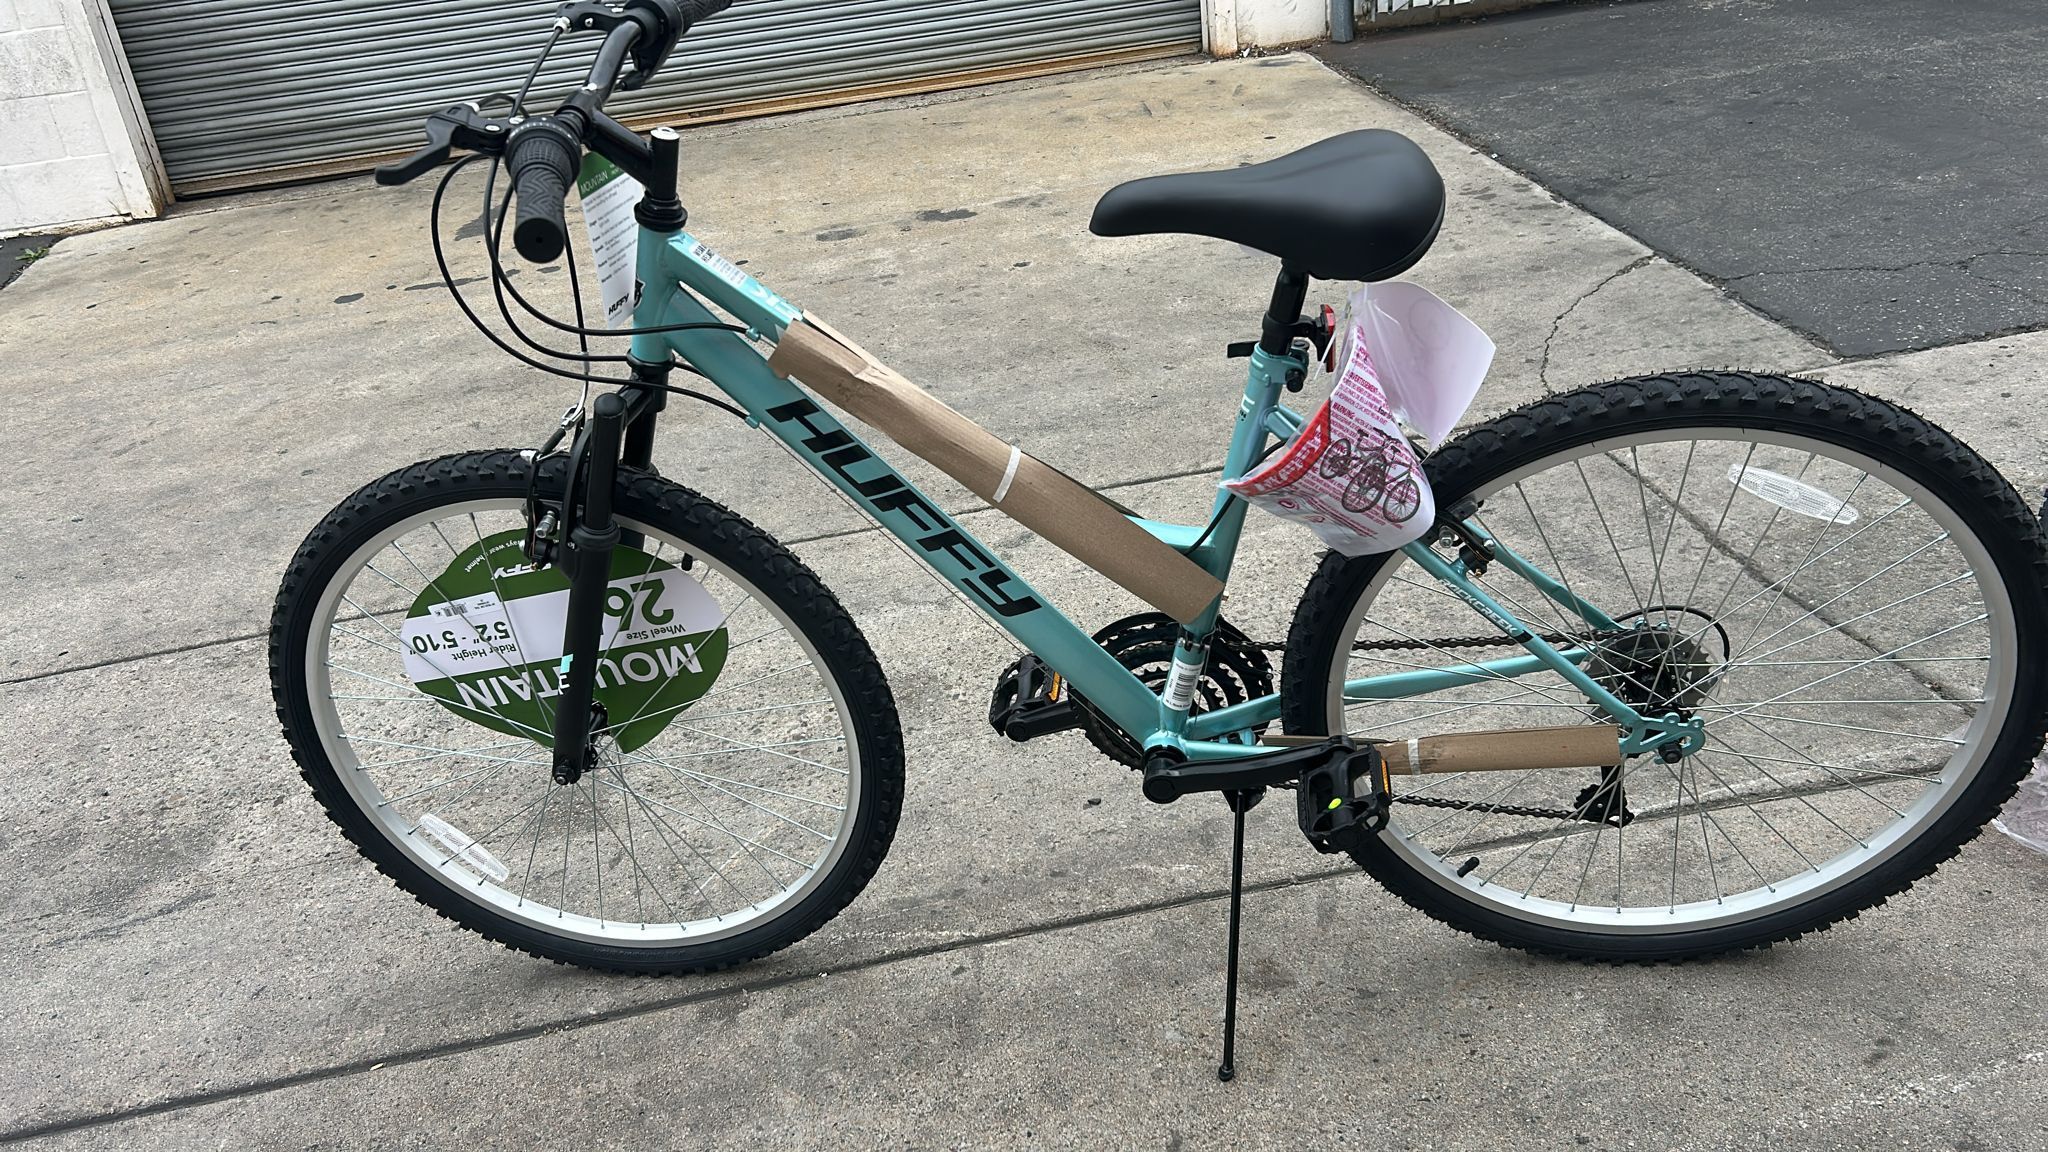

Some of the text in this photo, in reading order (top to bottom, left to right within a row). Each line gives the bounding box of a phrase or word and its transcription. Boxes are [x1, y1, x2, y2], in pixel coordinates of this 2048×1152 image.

[580, 170, 608, 194] MOUNTAIN
[608, 293, 629, 315] HUFFY
[766, 398, 1043, 617] HUFFY
[465, 554, 486, 573] helmet
[626, 624, 686, 640] Wheel Size
[452, 643, 517, 661] Rider Height
[455, 643, 703, 709] MOUTAIN
